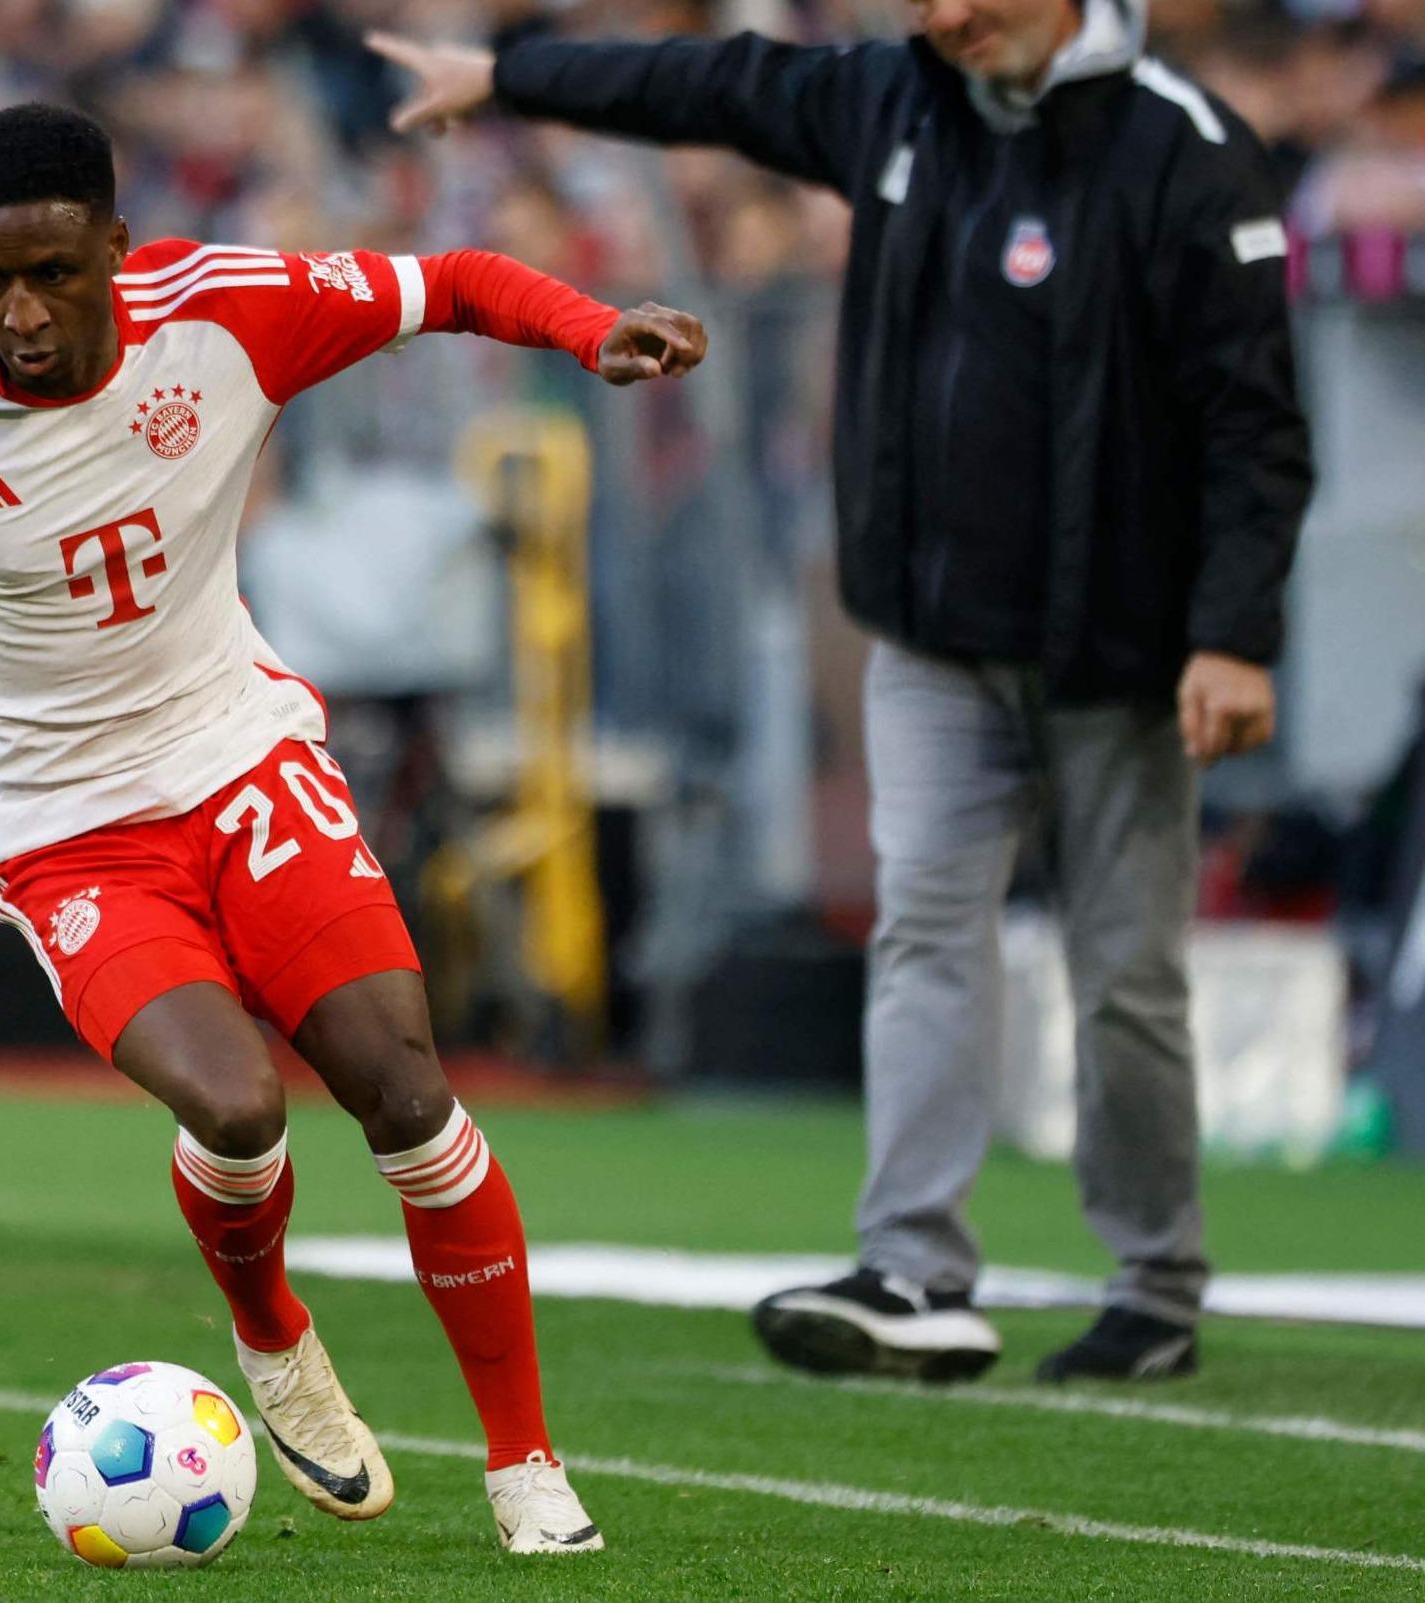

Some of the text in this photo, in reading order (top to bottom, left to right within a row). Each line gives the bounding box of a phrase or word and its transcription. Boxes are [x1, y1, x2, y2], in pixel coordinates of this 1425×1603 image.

[156, 406, 192, 422] BAYERN
[59, 507, 168, 630] T
[214, 761, 359, 882] 20
[432, 1255, 515, 1288] BAYERN
